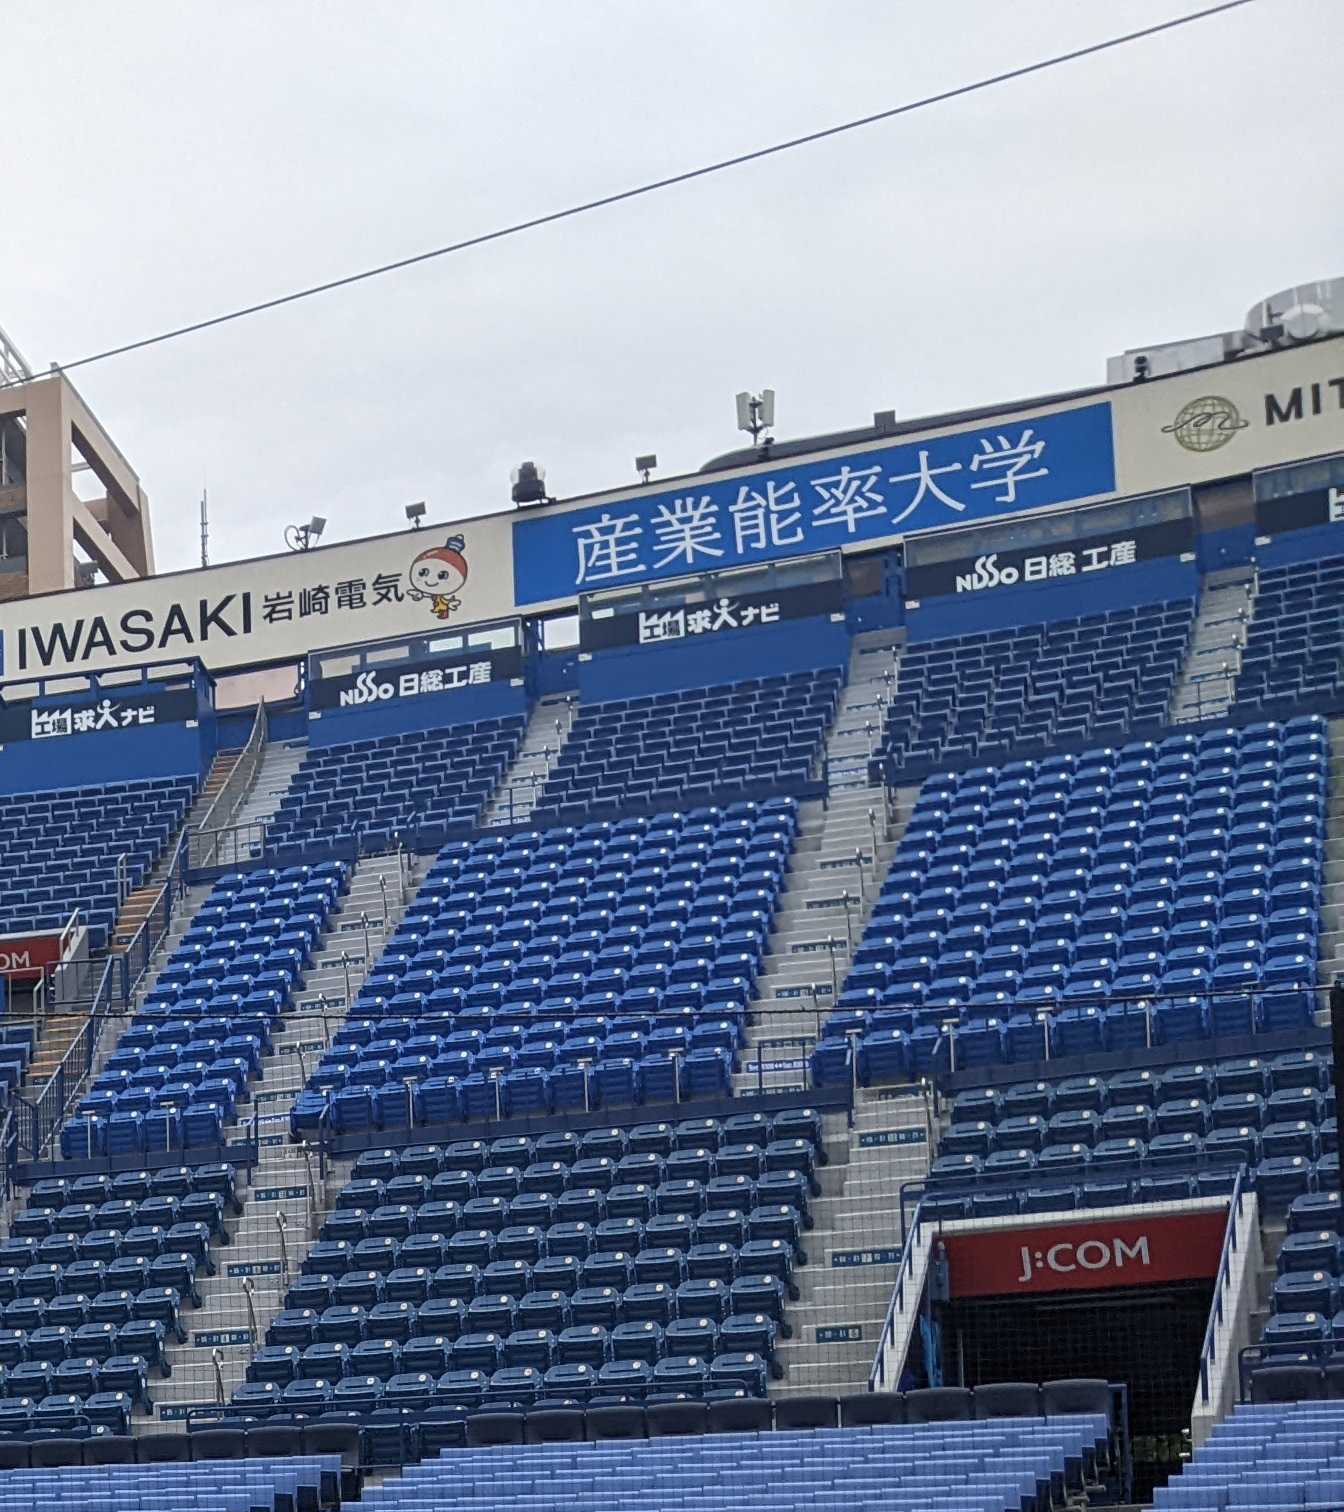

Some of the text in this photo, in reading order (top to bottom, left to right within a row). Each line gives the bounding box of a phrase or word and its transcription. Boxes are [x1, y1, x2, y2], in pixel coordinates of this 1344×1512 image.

[1264, 377, 1344, 426] MIT
[572, 429, 1048, 586] 産業能率大学
[1023, 541, 1137, 582] 日総工産
[262, 572, 404, 627] 岩崎電気
[18, 591, 252, 671] IWASAKI
[399, 661, 492, 697] 日総工産
[1018, 1235, 1153, 1282] J:COM
